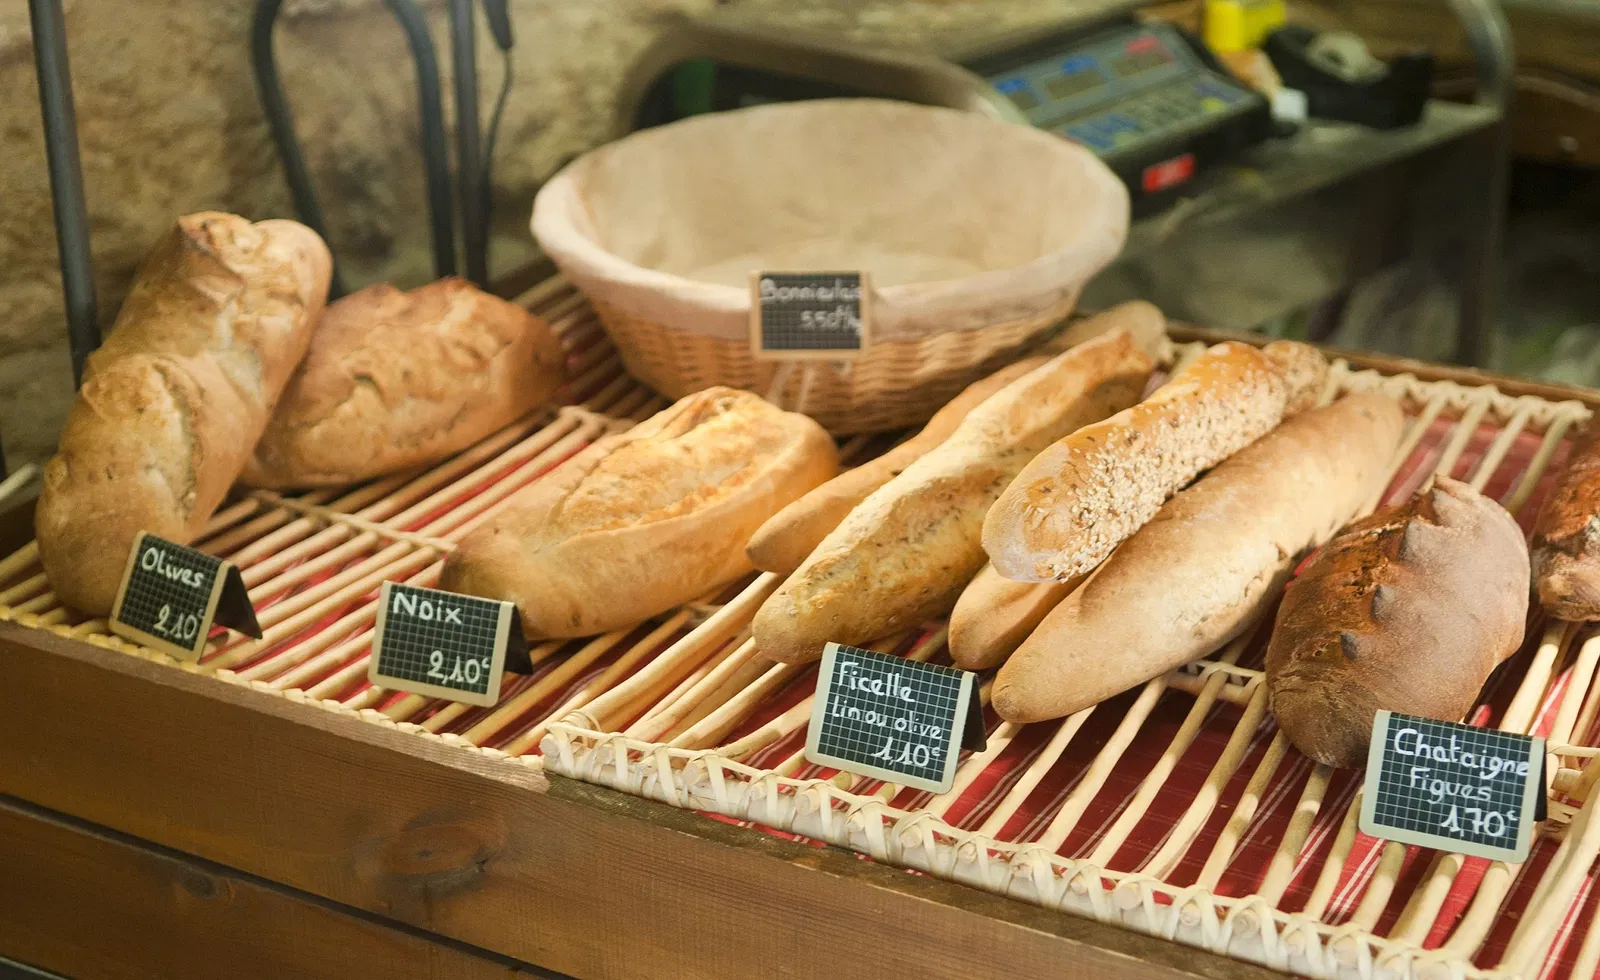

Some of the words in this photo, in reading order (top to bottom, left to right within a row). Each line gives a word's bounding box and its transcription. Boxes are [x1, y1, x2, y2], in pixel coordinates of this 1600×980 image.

[142, 547, 204, 588] Olives
[393, 592, 462, 624] Noix
[839, 661, 915, 702] Ficelle
[894, 710, 942, 740] olive
[870, 736, 941, 767] 1,10€
[1394, 728, 1530, 780] Chataigne
[1410, 767, 1493, 804] Figues
